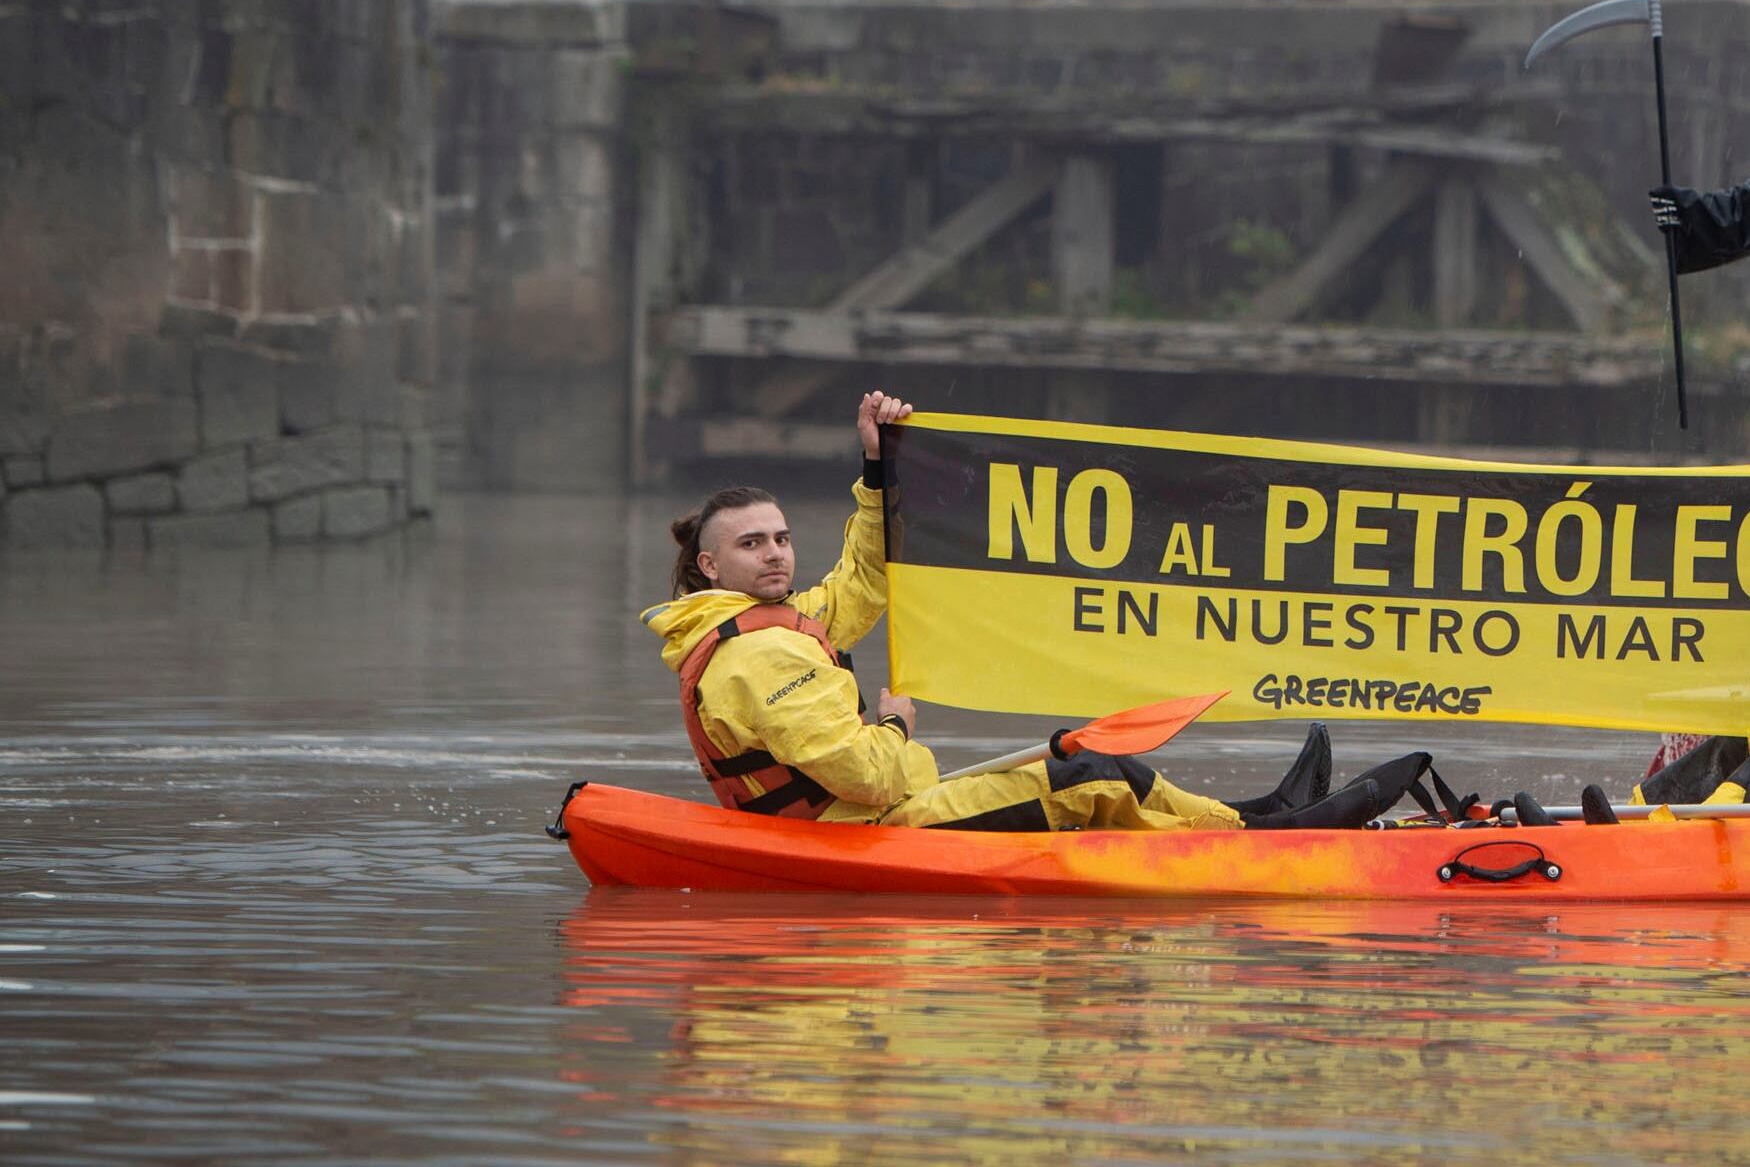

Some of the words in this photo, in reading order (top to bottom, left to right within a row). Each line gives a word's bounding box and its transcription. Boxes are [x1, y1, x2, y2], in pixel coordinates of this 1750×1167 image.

[986, 462, 1134, 570] NO
[1160, 522, 1231, 578] AL
[1073, 586, 1160, 638] EN
[1195, 595, 1521, 658] NUESTRO
[1556, 613, 1706, 663] MAR
[1252, 673, 1493, 716] GREENPEACE
